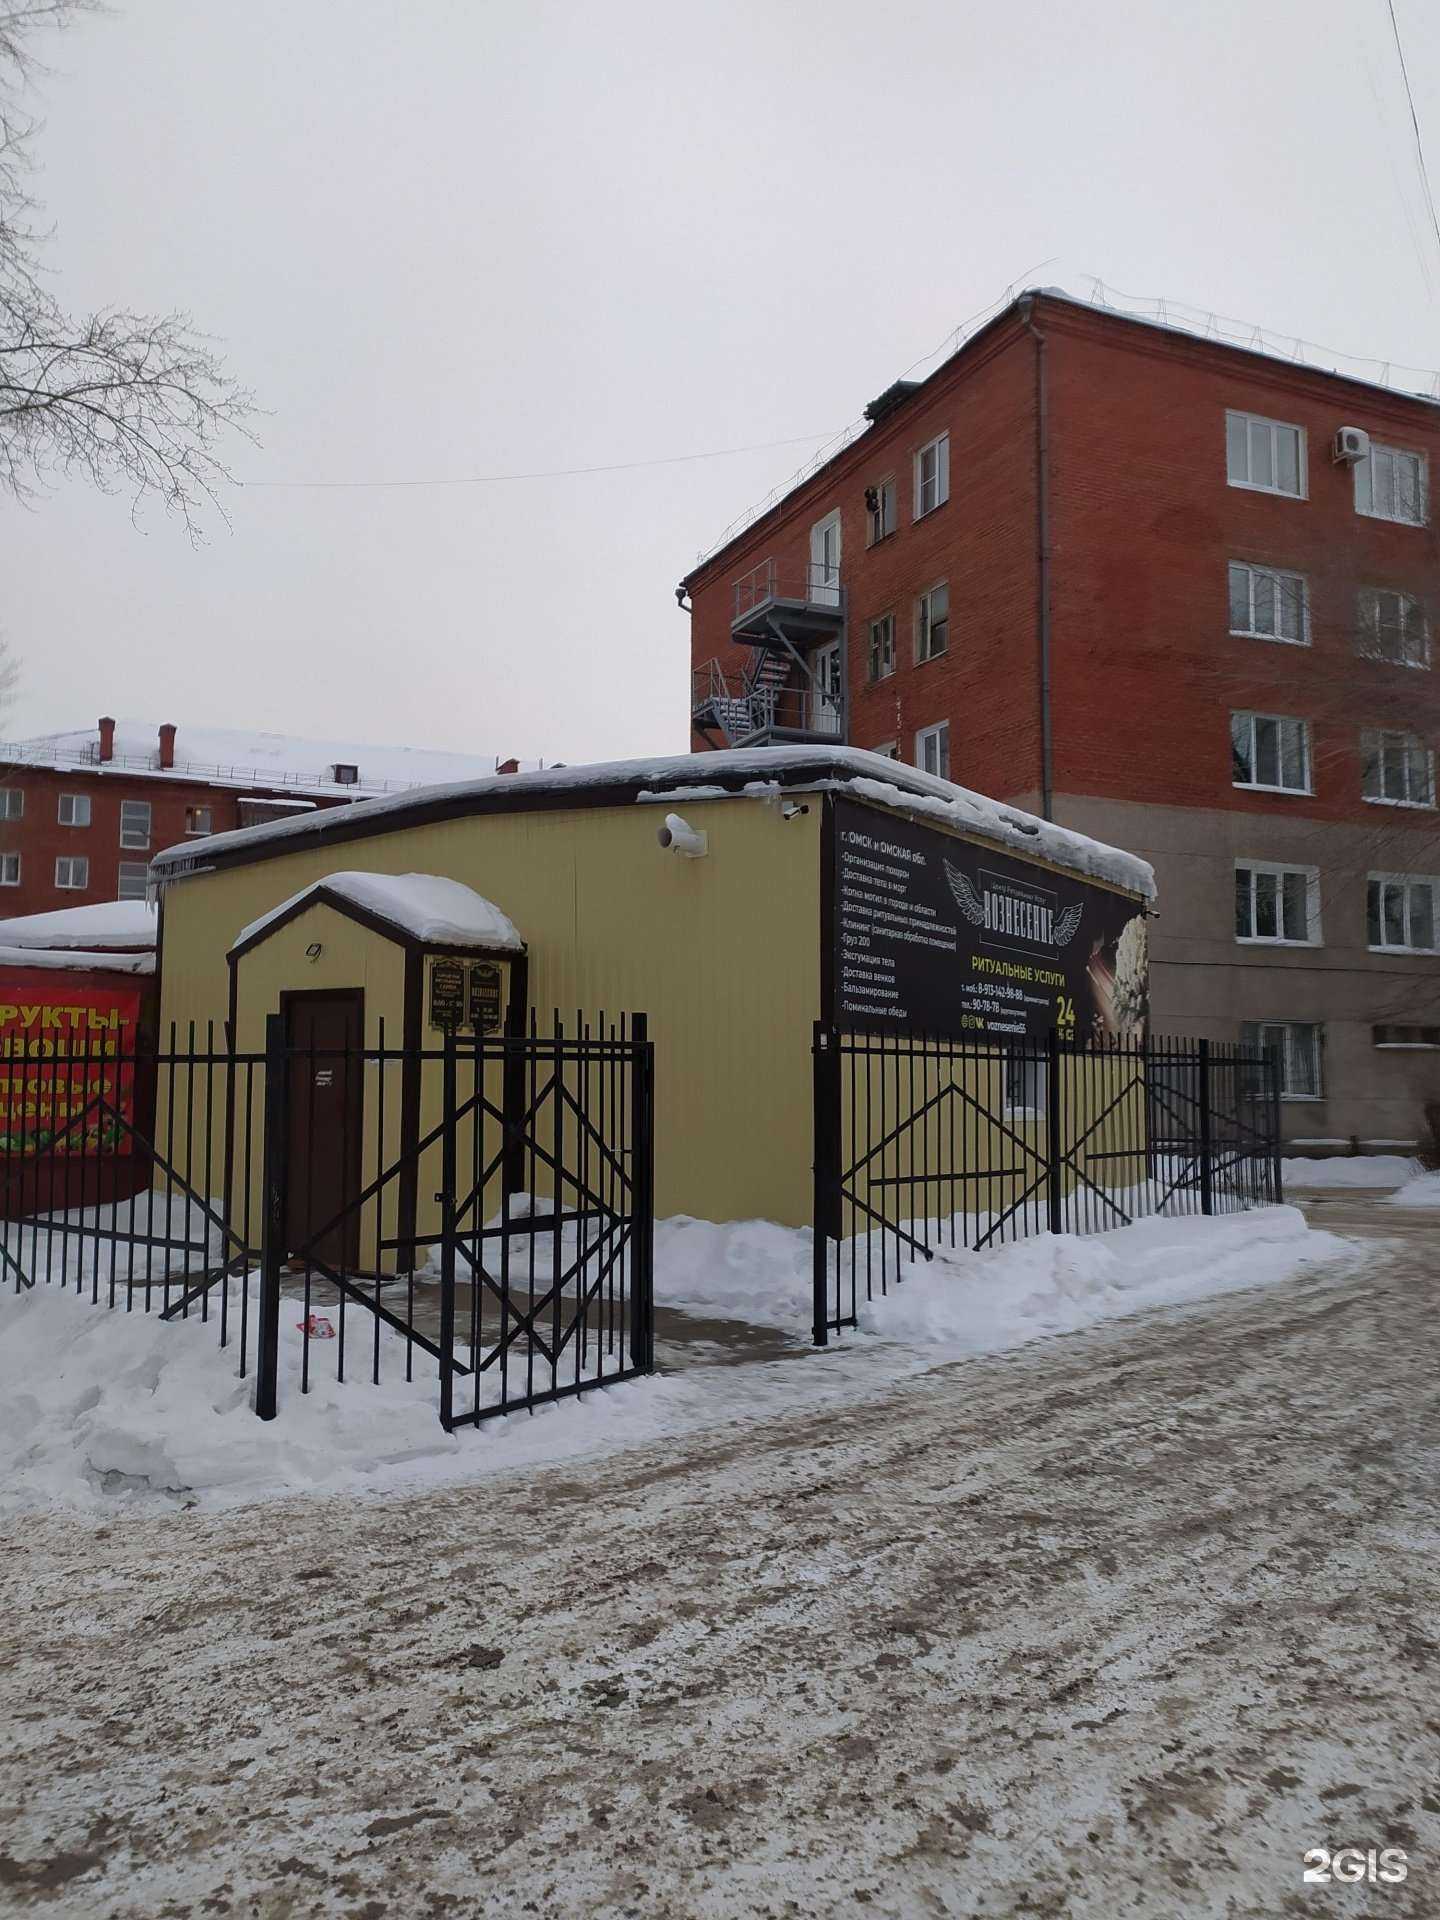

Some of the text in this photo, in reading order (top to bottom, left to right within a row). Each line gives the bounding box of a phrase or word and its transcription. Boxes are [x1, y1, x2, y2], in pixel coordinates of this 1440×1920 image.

[849, 831, 872, 849] ОМСК
[874, 841, 880, 851] и
[880, 841, 912, 861] ОМСКАЯ
[912, 852, 927, 866] обл.
[841, 867, 873, 885] -Доставка
[874, 877, 888, 889] тела
[893, 883, 908, 895] морг
[885, 865, 910, 880] похорон
[841, 901, 873, 917] -Доставка
[864, 891, 882, 903] могил
[888, 898, 909, 911] городе
[914, 903, 937, 917] области
[984, 890, 1053, 945] ВОЗНЕСЕНИЕ
[841, 932, 871, 947] -Груз 200
[881, 957, 895, 968] тела
[971, 955, 1066, 987] РИТУАЛЬНЫЕ УСЛУГИ
[841, 966, 896, 984] -Доставка венков
[841, 981, 900, 999] -Бальзамирование
[841, 1000, 888, 1016] -Поминальные
[1056, 995, 1076, 1026] 24
